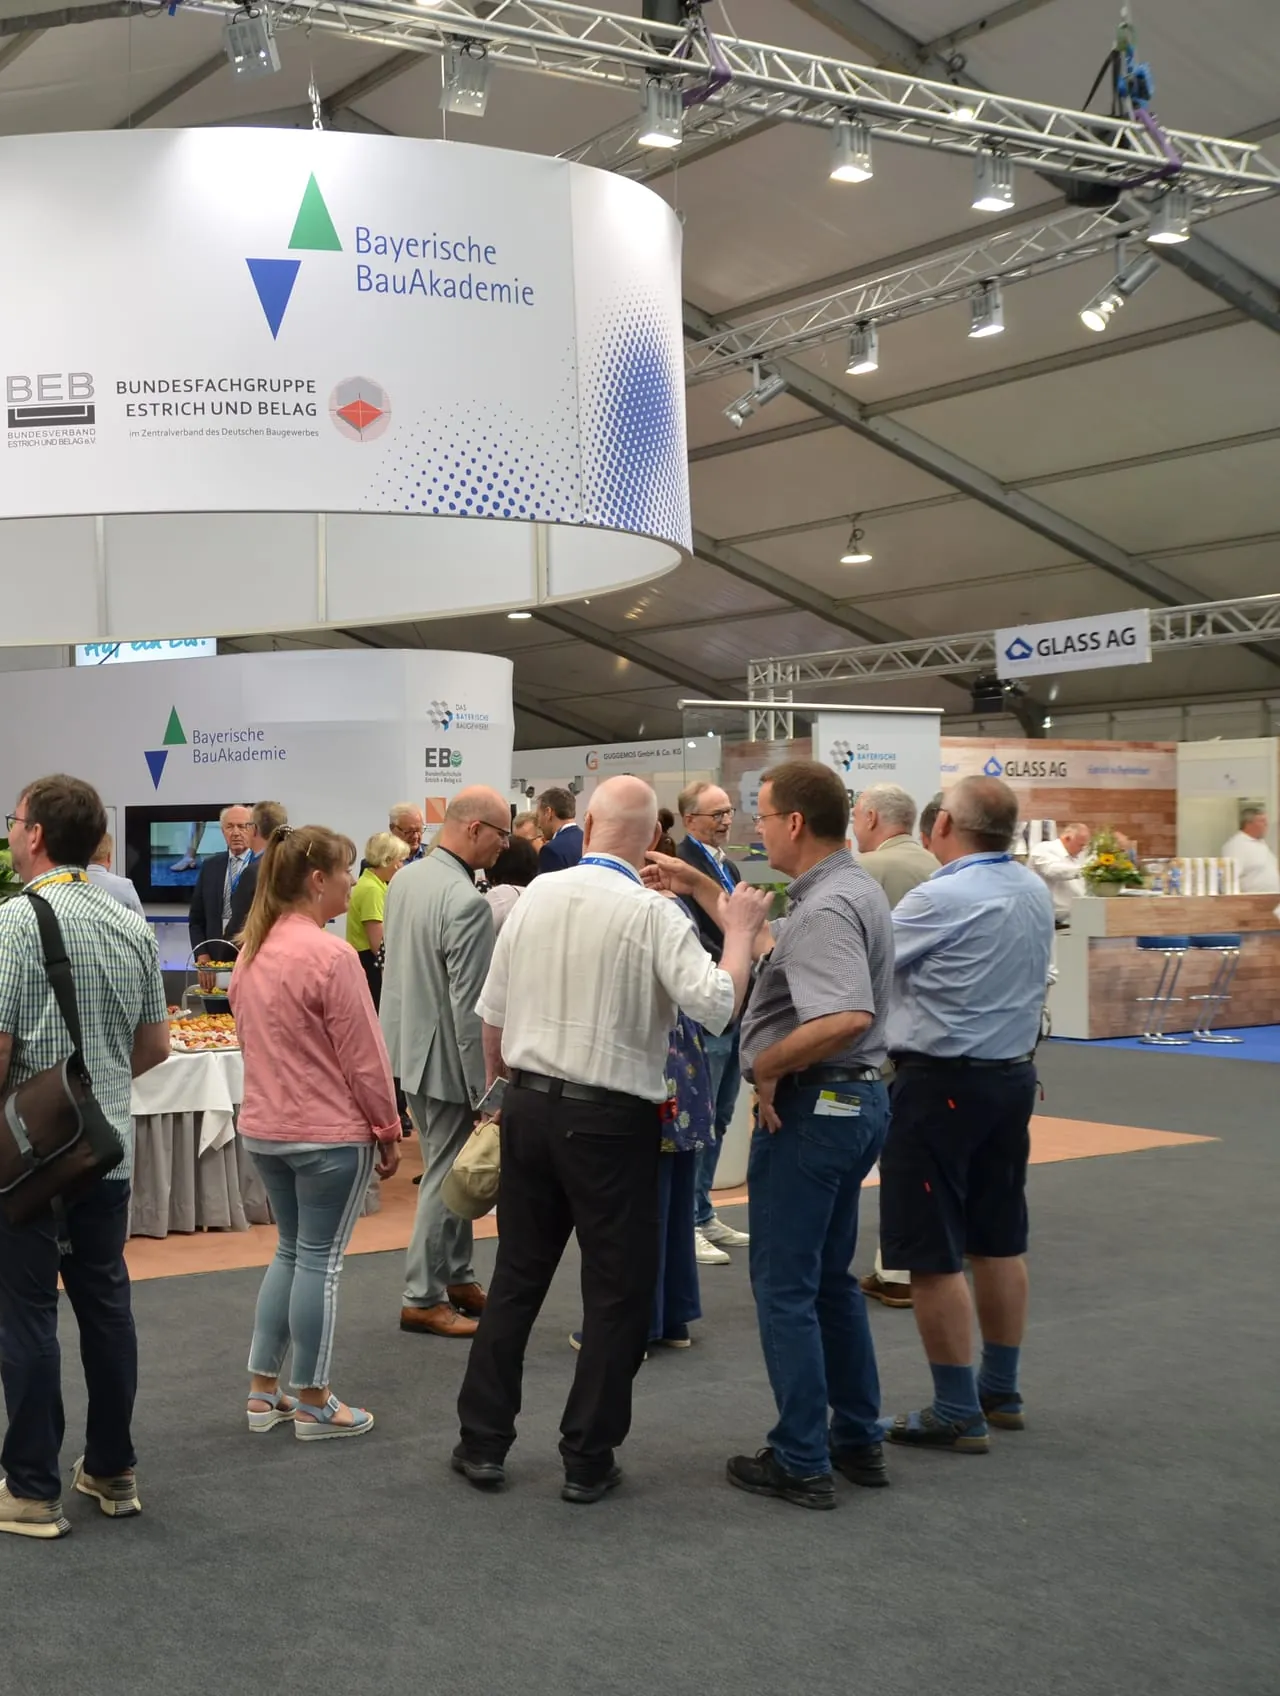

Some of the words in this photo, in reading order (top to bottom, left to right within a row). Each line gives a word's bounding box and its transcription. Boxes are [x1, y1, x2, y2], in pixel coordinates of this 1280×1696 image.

[355, 226, 497, 265] Bayerische
[356, 264, 535, 306] BauAkademie
[6, 372, 95, 403] BEB
[116, 378, 317, 394] BUNDESFACHGRUPPE
[126, 402, 205, 417] ESTRICH
[211, 401, 252, 416] UND
[258, 402, 317, 416] BELAG
[7, 428, 96, 439] BUNDESVERBAND
[129, 429, 140, 437] im
[141, 428, 204, 437] Zentralverband
[206, 428, 220, 436] des
[221, 428, 264, 436] Deutschen
[266, 428, 320, 438] Baugewerbes
[7, 439, 40, 448] ESTRICH
[41, 438, 57, 446] UND
[59, 437, 83, 446] BELAG
[1037, 631, 1101, 657] GLASS
[1106, 627, 1136, 648] AG
[192, 728, 264, 746] Bayerische
[193, 746, 287, 764] BauAkademie
[1005, 761, 1046, 777] GLASS
[1049, 761, 1067, 777] AG
